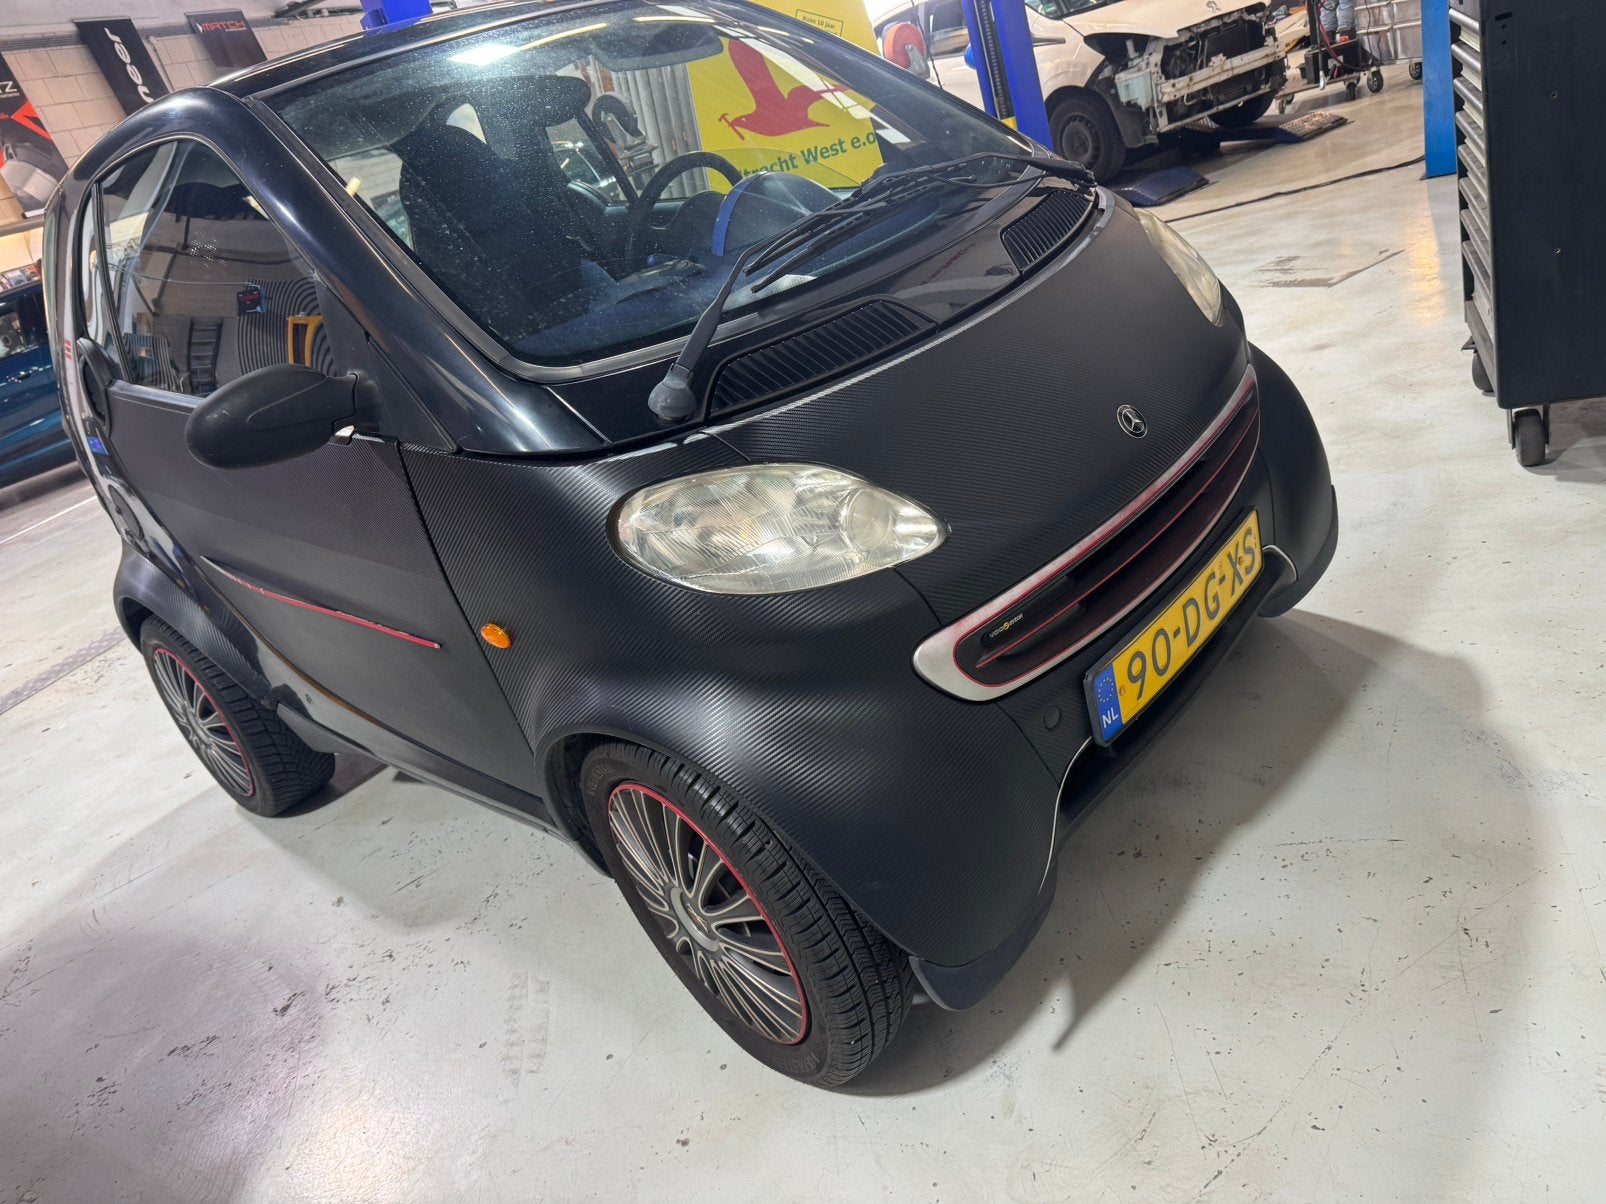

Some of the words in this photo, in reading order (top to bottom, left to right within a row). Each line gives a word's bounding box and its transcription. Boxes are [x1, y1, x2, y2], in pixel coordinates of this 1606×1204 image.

[801, 138, 848, 165] West
[1127, 528, 1256, 701] 90-DG-XS
[1102, 707, 1119, 729] NL
